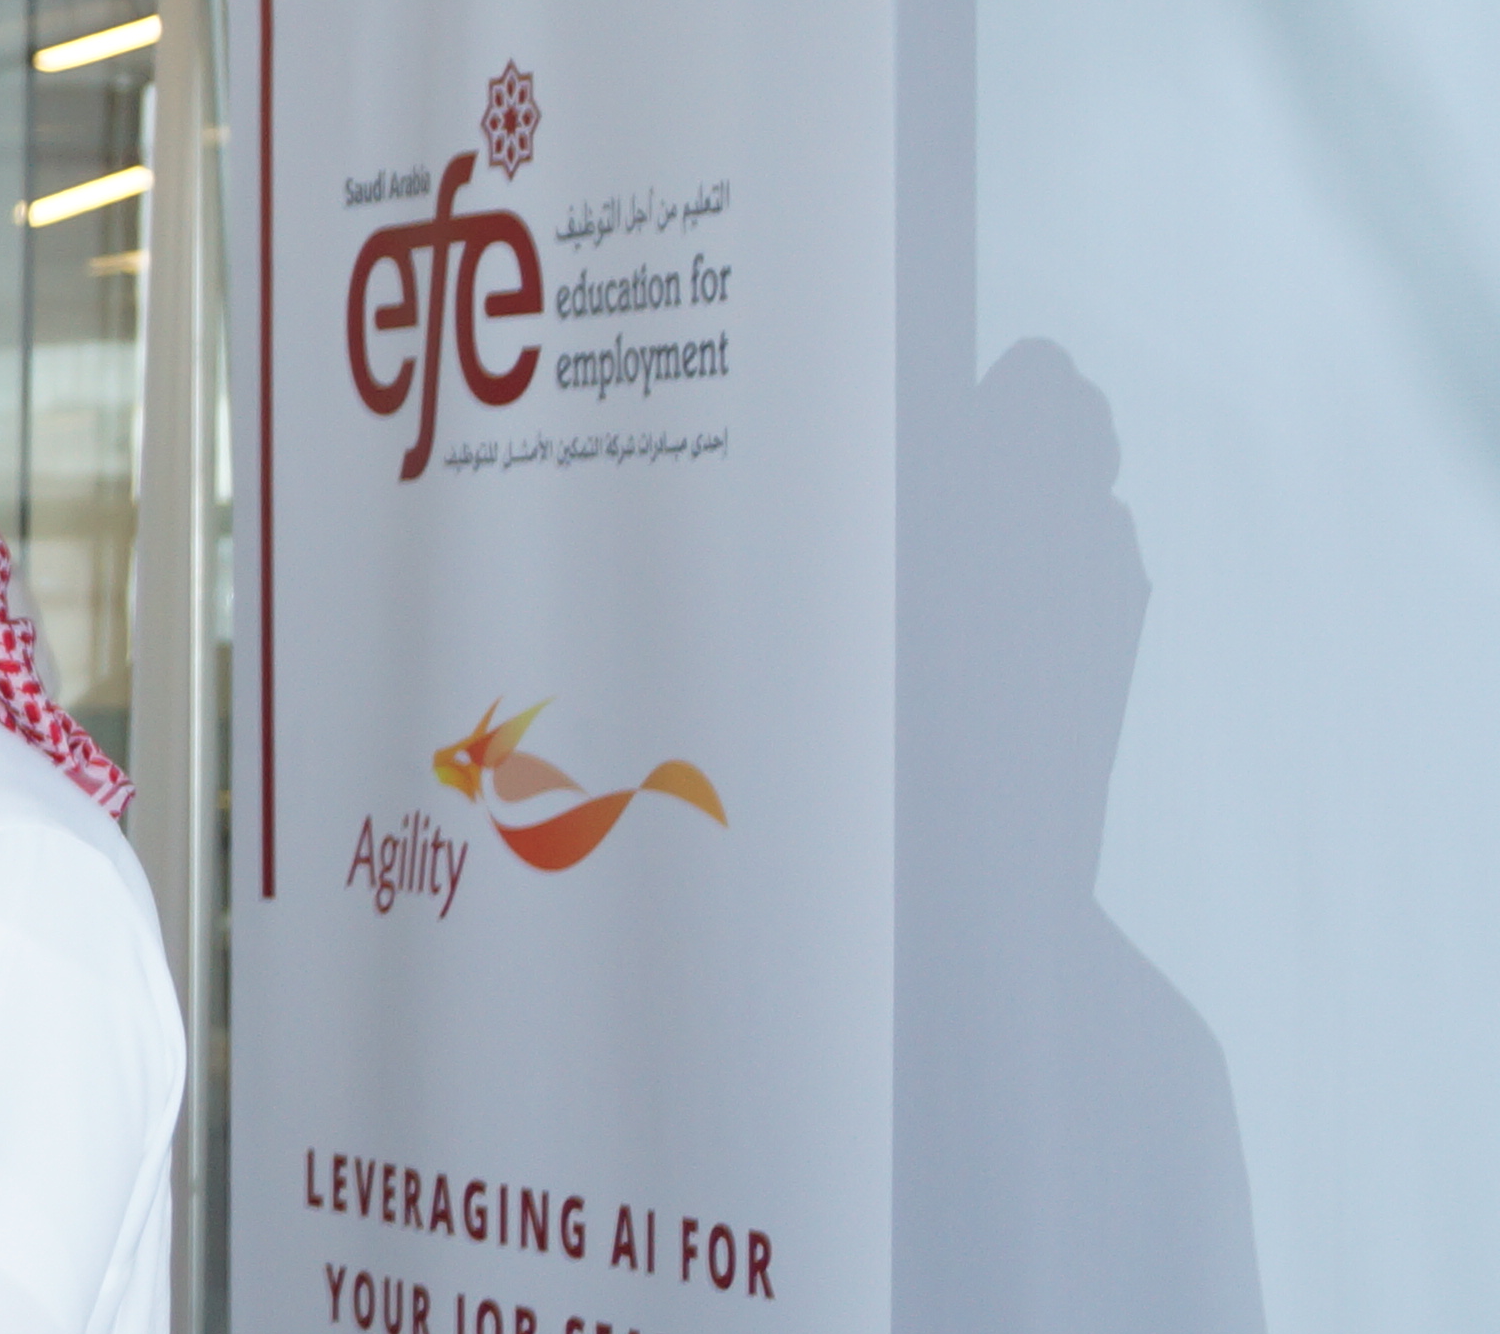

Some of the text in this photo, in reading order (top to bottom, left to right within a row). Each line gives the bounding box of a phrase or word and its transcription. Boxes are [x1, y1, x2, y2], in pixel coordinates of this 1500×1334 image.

[346, 165, 431, 206] Saudi Arabia
[556, 179, 730, 251] التعليم من أجل التوظيف
[346, 150, 544, 482] efe
[556, 252, 732, 320] education for
[556, 329, 730, 400] employment
[346, 809, 468, 921] Agility
[306, 1148, 775, 1300] LEVERAGING AI FOR
